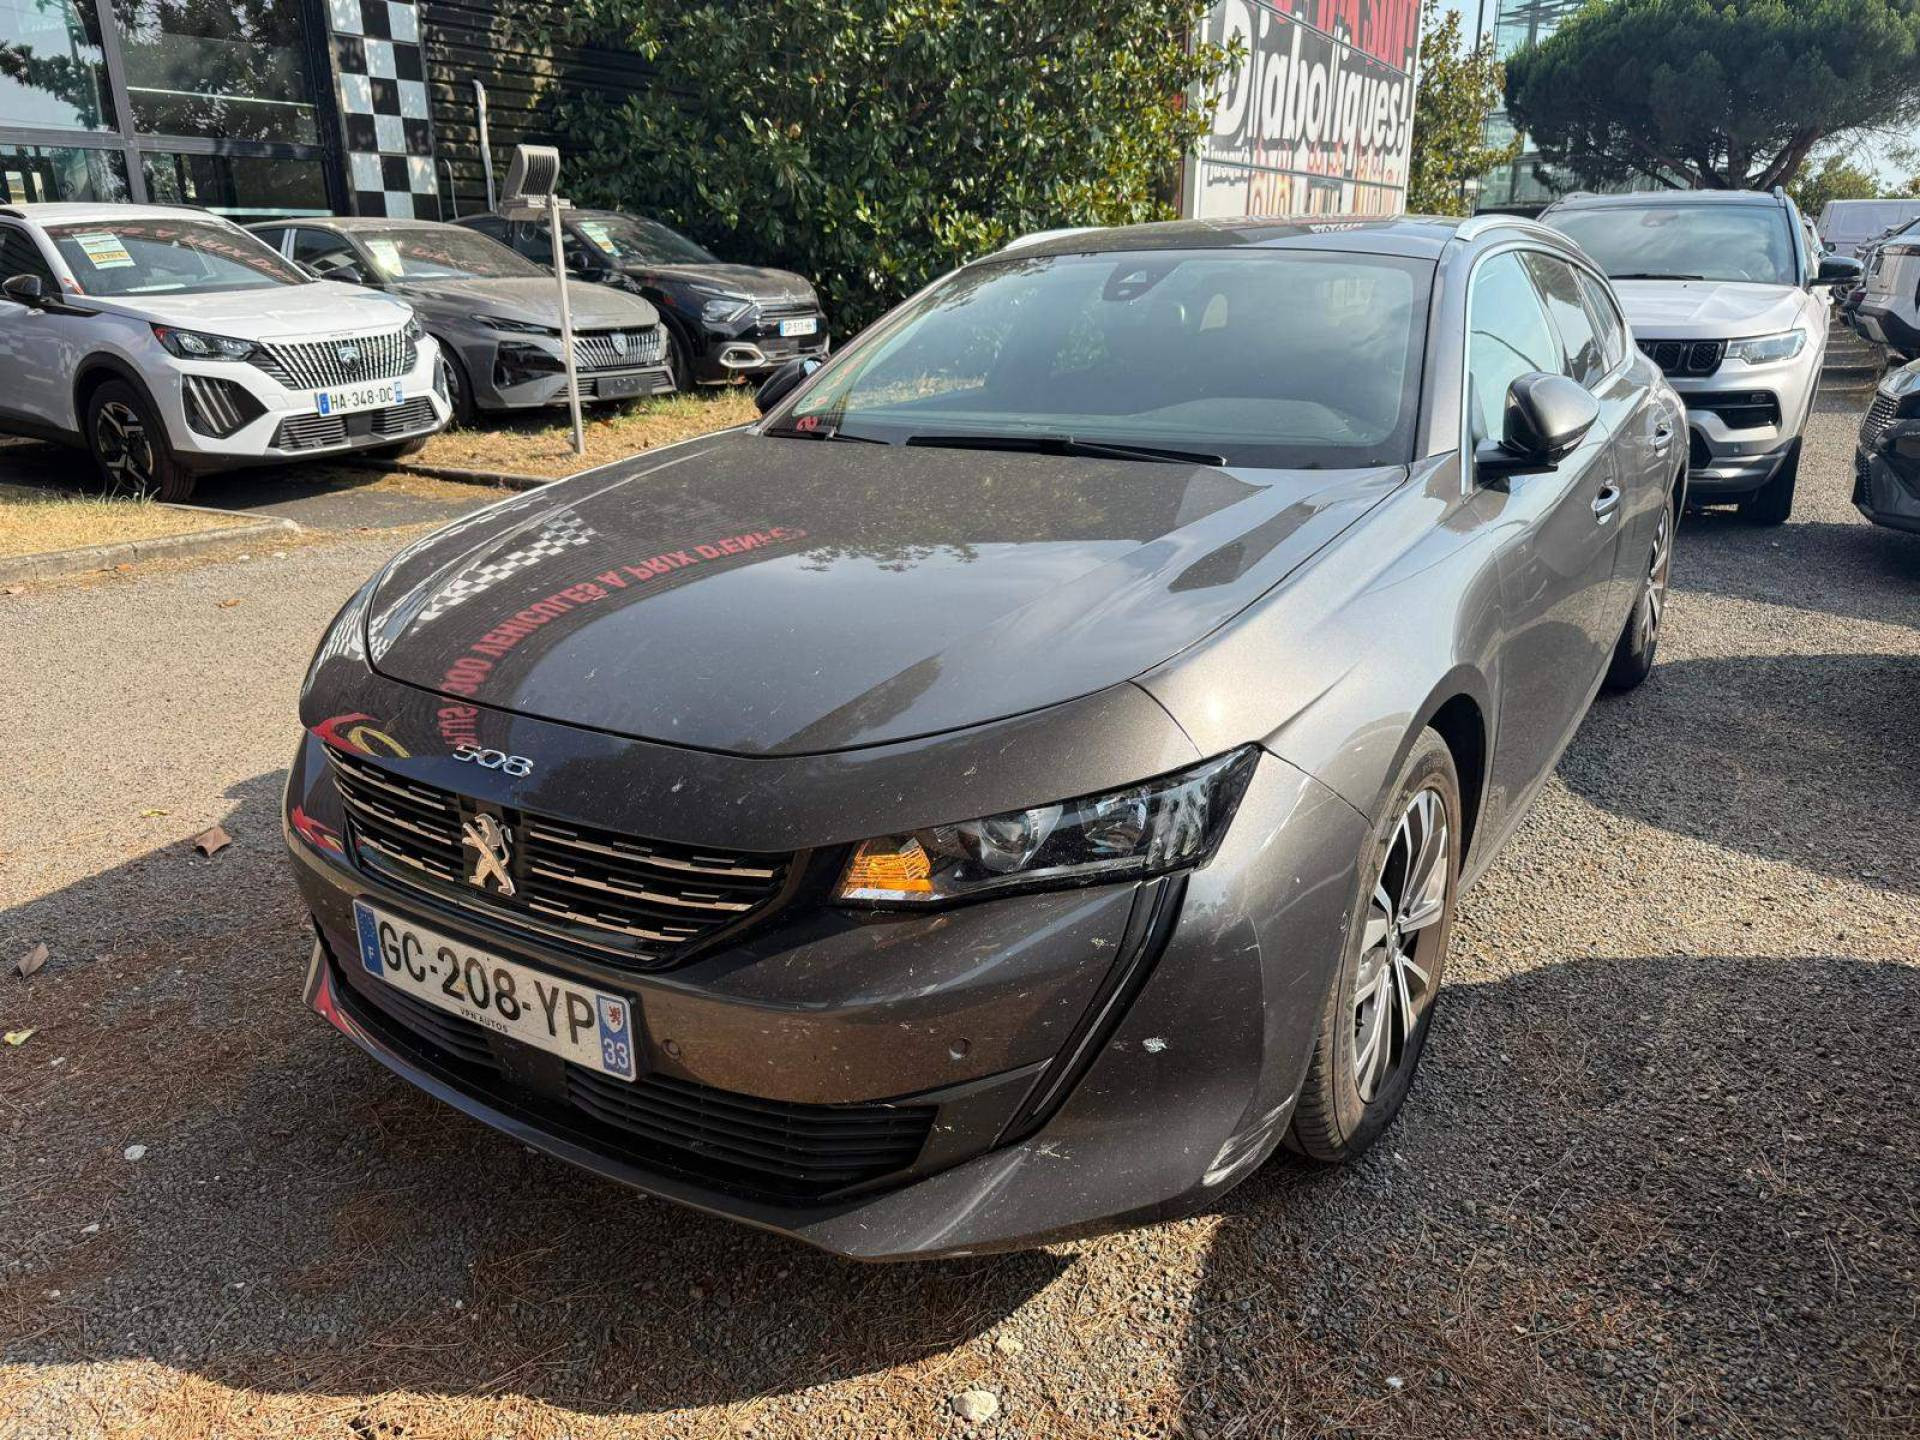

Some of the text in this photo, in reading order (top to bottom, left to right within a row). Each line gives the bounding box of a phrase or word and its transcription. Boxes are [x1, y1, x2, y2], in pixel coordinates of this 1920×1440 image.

[1212, 0, 1411, 170] Diaboliques!
[330, 386, 394, 410] HA-348-DC
[452, 743, 534, 777] 508
[378, 920, 595, 1045] GC-208-YP
[478, 1015, 509, 1034] AUTOS
[603, 1038, 629, 1069] 33
